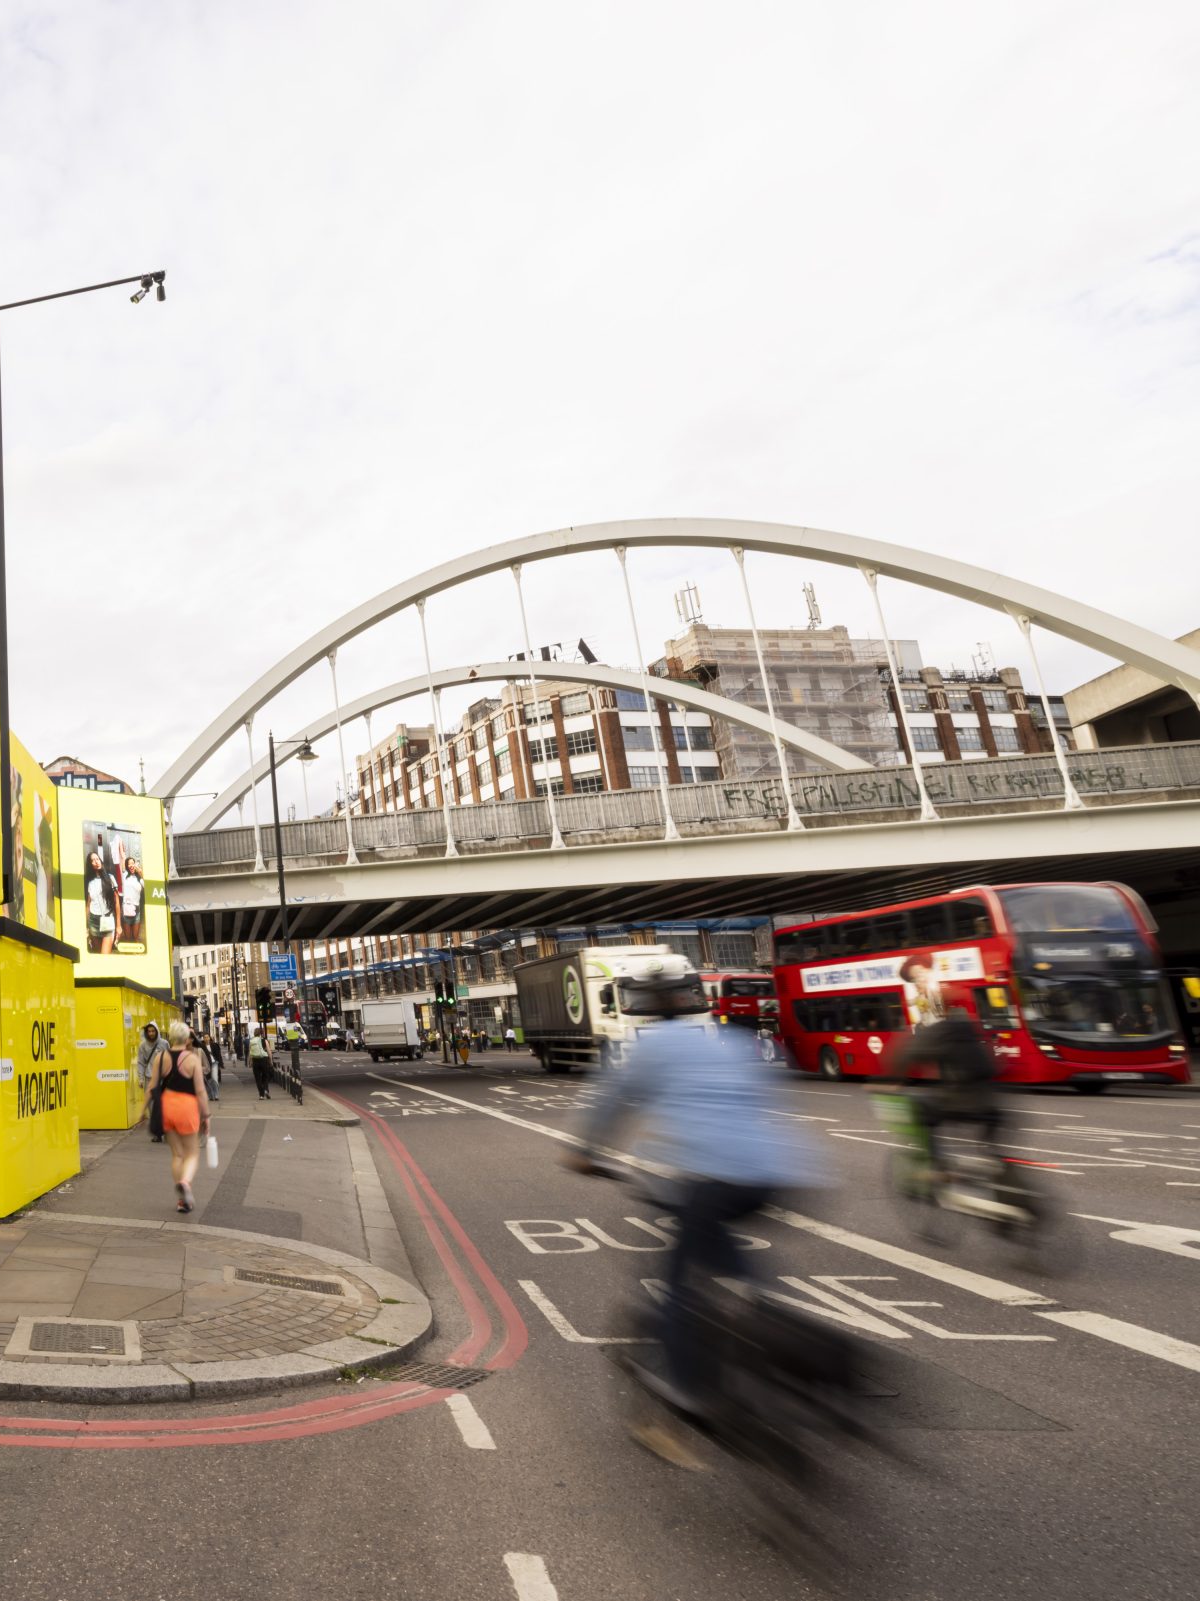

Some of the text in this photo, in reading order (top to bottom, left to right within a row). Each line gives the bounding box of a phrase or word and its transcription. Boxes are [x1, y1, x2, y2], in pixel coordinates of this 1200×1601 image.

[31, 1020, 56, 1062] ONE
[17, 1069, 69, 1119] MOMENT
[517, 1275, 1056, 1344] LNE
